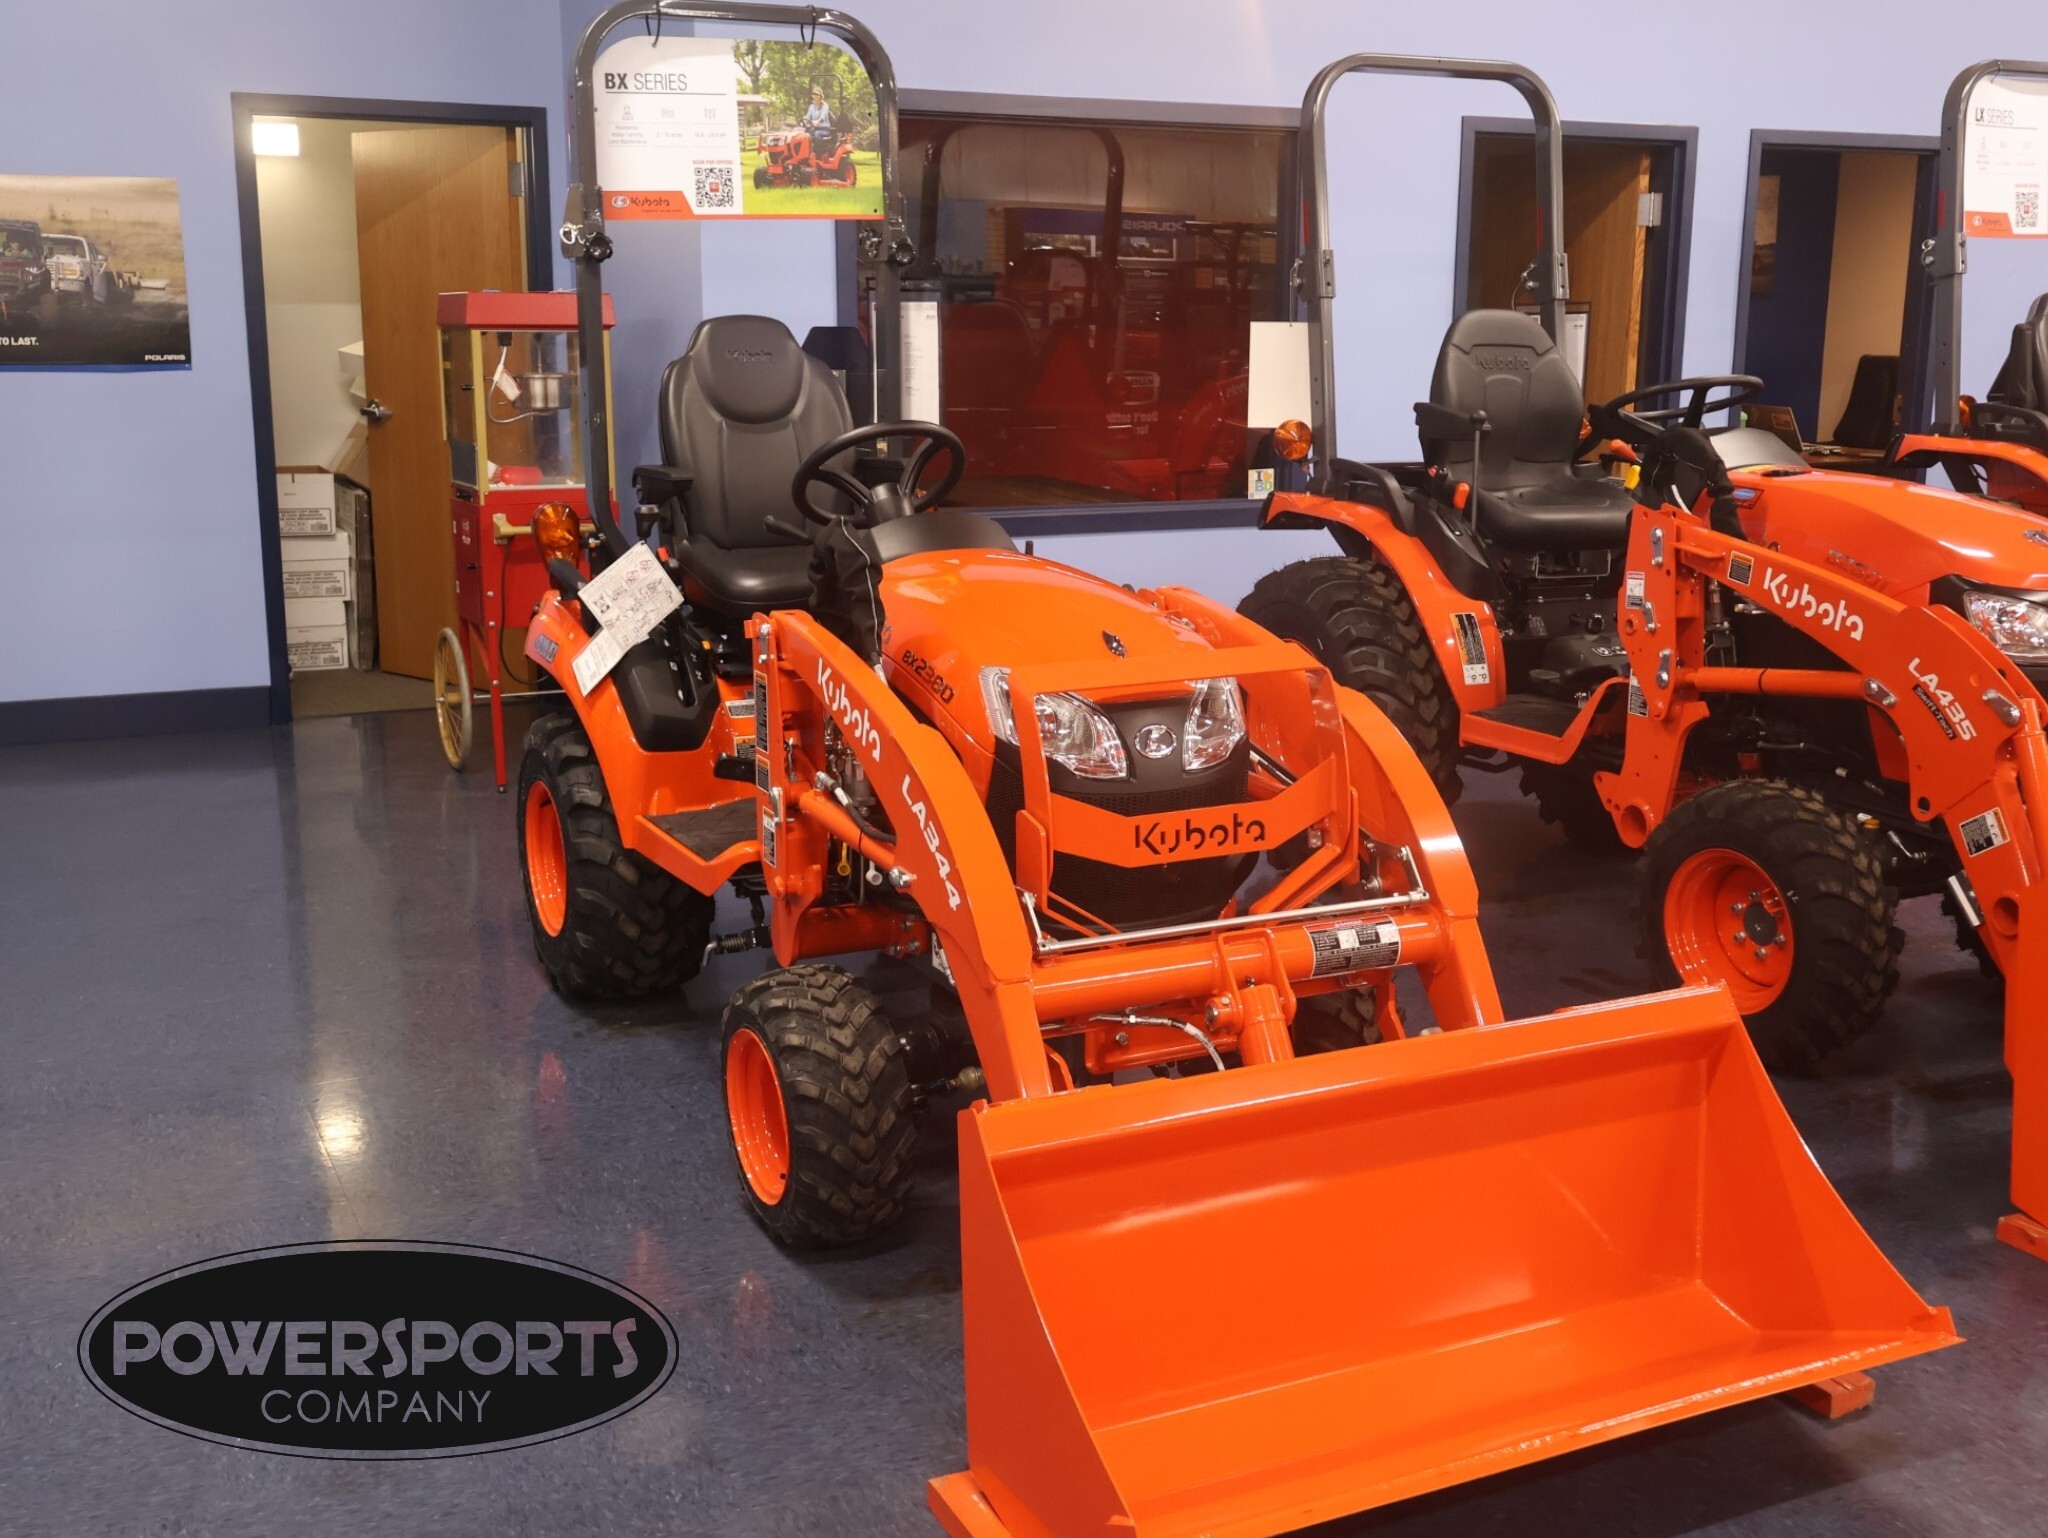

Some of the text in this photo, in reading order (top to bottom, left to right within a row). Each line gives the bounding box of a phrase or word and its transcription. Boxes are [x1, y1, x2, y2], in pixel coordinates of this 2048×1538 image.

[604, 72, 688, 91] BX SERIES
[1975, 107, 2014, 125] LX SERIES
[630, 196, 670, 207] Kubota
[11, 336, 40, 346] LAST.
[144, 354, 186, 362] POLARIS
[1474, 352, 1531, 370] Kubota
[1762, 566, 1864, 641] Kubota
[1908, 657, 1978, 741] LA435
[817, 657, 882, 762] Kubota
[901, 774, 961, 912] LA344
[1134, 812, 1266, 855] Kubota
